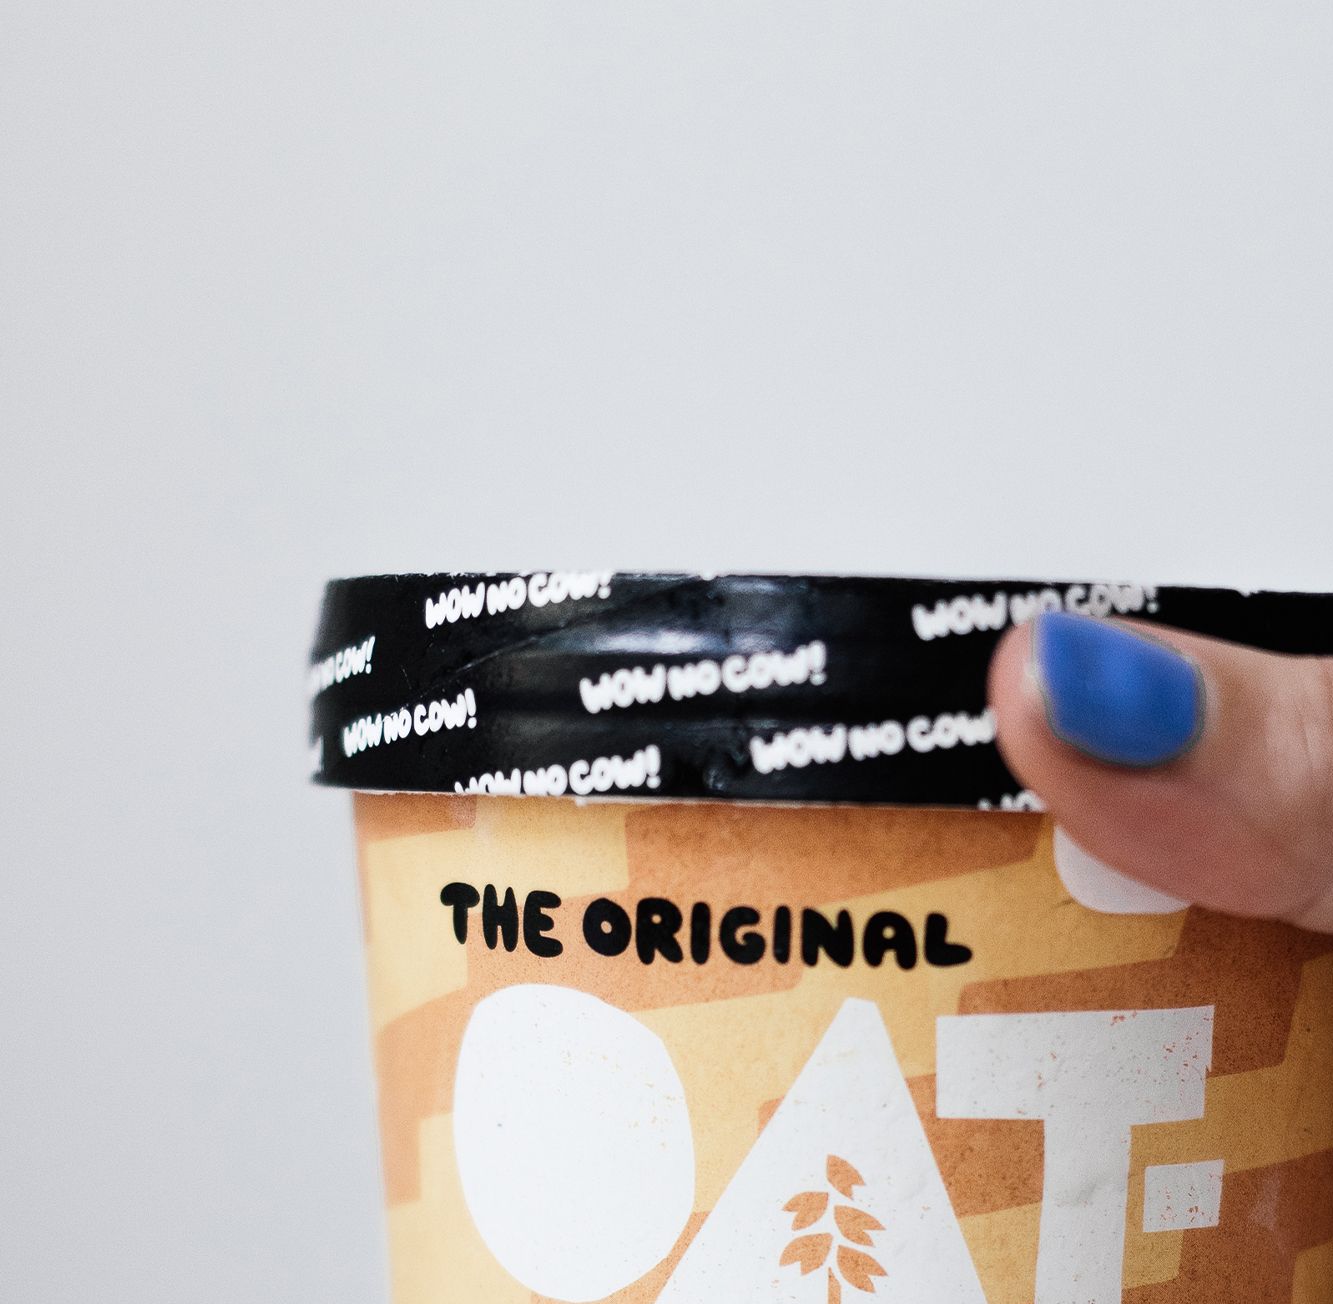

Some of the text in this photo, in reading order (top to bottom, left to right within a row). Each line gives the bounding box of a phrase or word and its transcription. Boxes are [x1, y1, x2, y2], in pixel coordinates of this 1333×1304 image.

[425, 573, 613, 629] WOW NO COW!
[911, 591, 1007, 641] WOW
[336, 636, 375, 683] COW!
[579, 640, 827, 713] WOW NO COW!
[343, 713, 382, 758] WOW
[384, 707, 411, 744] NO
[413, 688, 477, 736] COW!
[750, 708, 996, 774] WOW NO COW
[523, 764, 568, 796] NO
[569, 745, 661, 796] COW!
[440, 881, 973, 970] THE ORIGINAL
